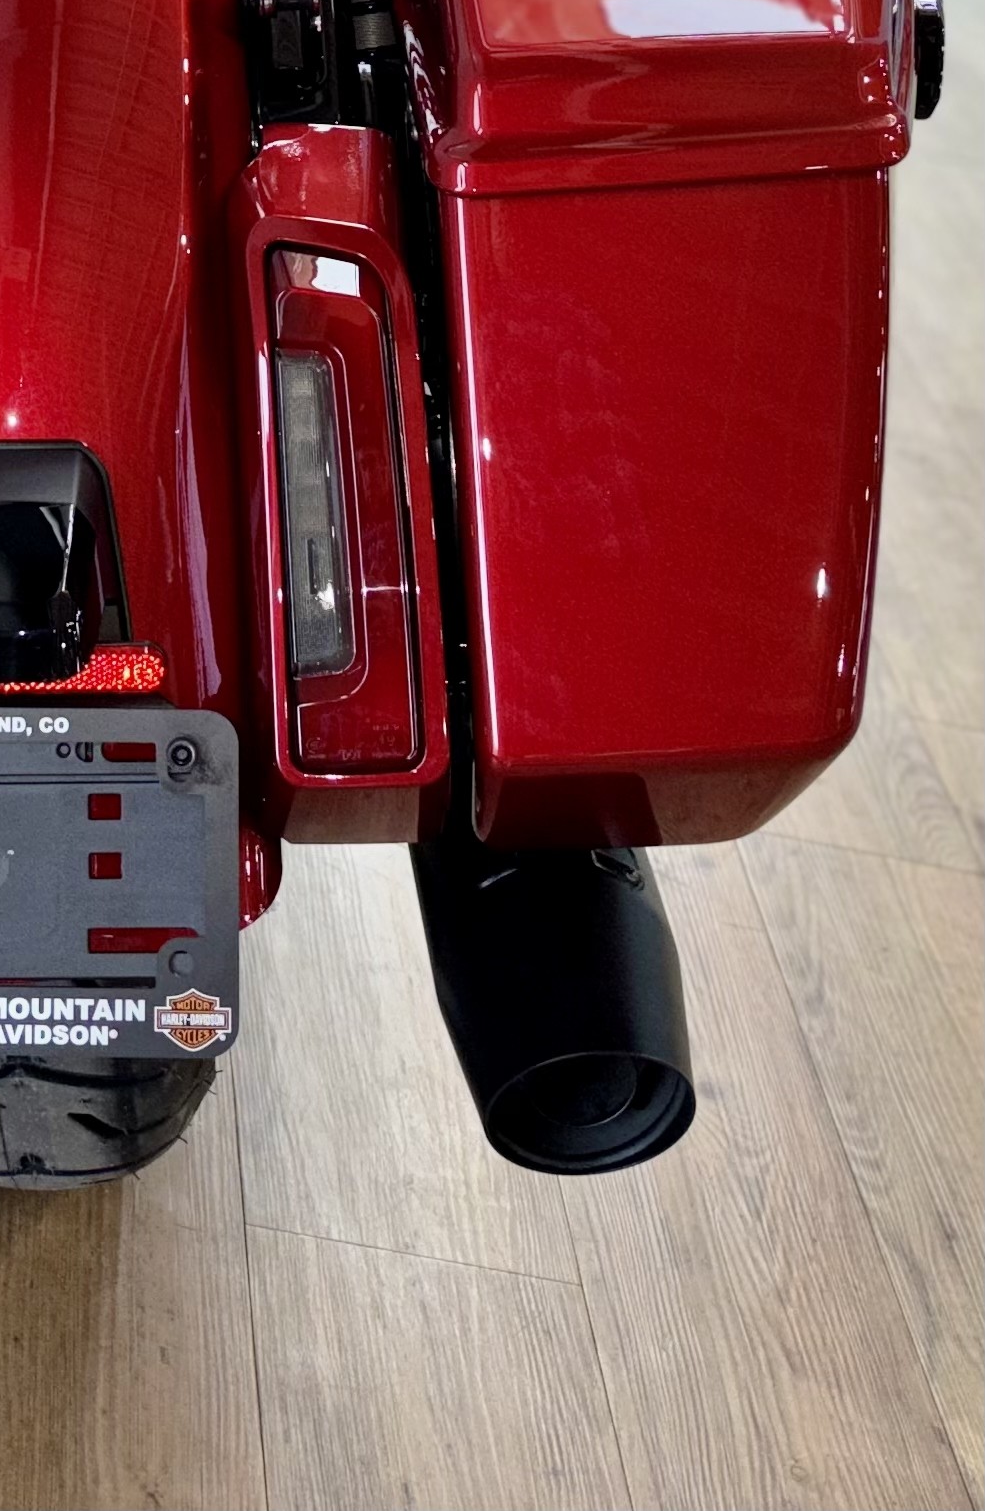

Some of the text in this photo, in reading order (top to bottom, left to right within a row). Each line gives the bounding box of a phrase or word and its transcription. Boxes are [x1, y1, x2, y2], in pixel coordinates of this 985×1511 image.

[38, 717, 70, 734] CO
[176, 997, 211, 1010] MOTOR
[161, 1013, 225, 1026] HARLEY-DAVIDSON
[176, 1029, 211, 1044] CYCLES
